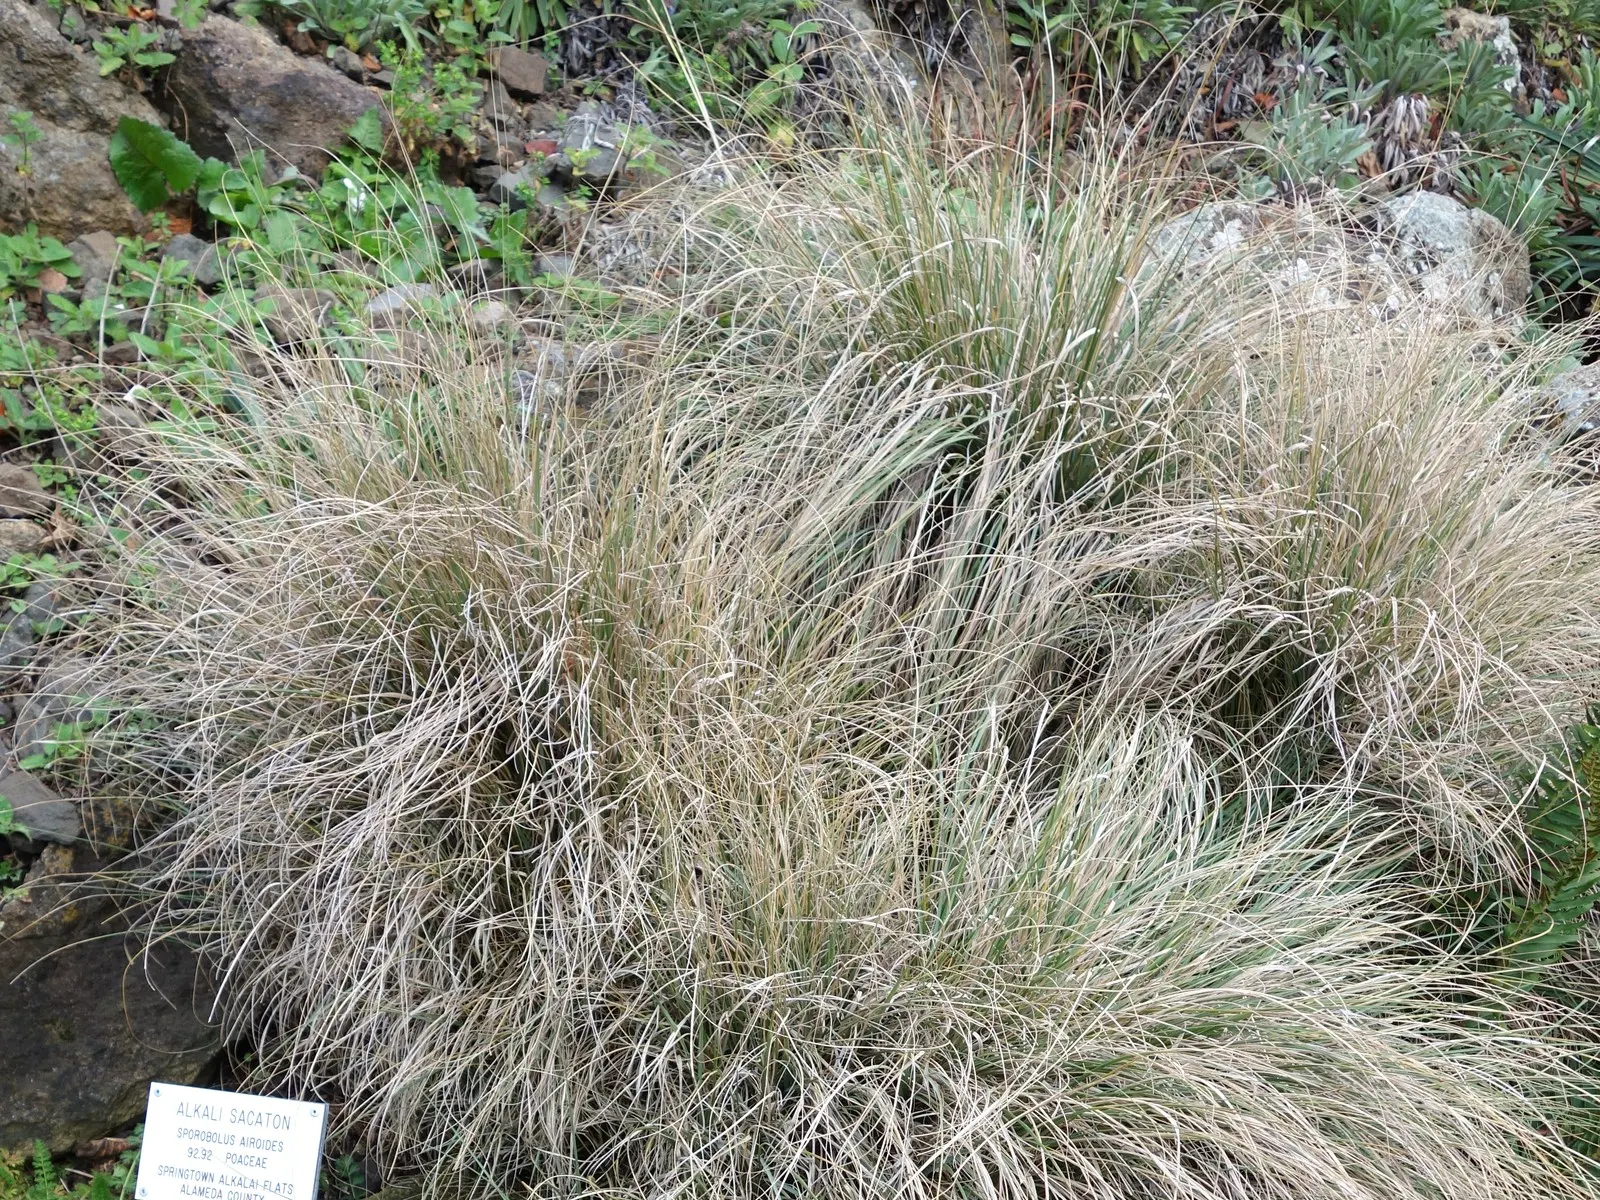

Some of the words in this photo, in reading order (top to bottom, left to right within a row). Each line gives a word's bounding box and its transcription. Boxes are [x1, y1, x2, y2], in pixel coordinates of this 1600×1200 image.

[177, 1102, 223, 1121] ALKALI
[230, 1108, 291, 1130] SACATON
[177, 1127, 235, 1145] SPOROBOLUS
[240, 1137, 283, 1152] AIROIDES
[188, 1147, 212, 1161] 92.92
[226, 1153, 267, 1168] POACEAE
[158, 1165, 214, 1183] SPRINGTOWN
[219, 1174, 259, 1190] ALKALAI
[263, 1180, 293, 1194] FLATS
[180, 1184, 222, 1199] ALAMEDA
